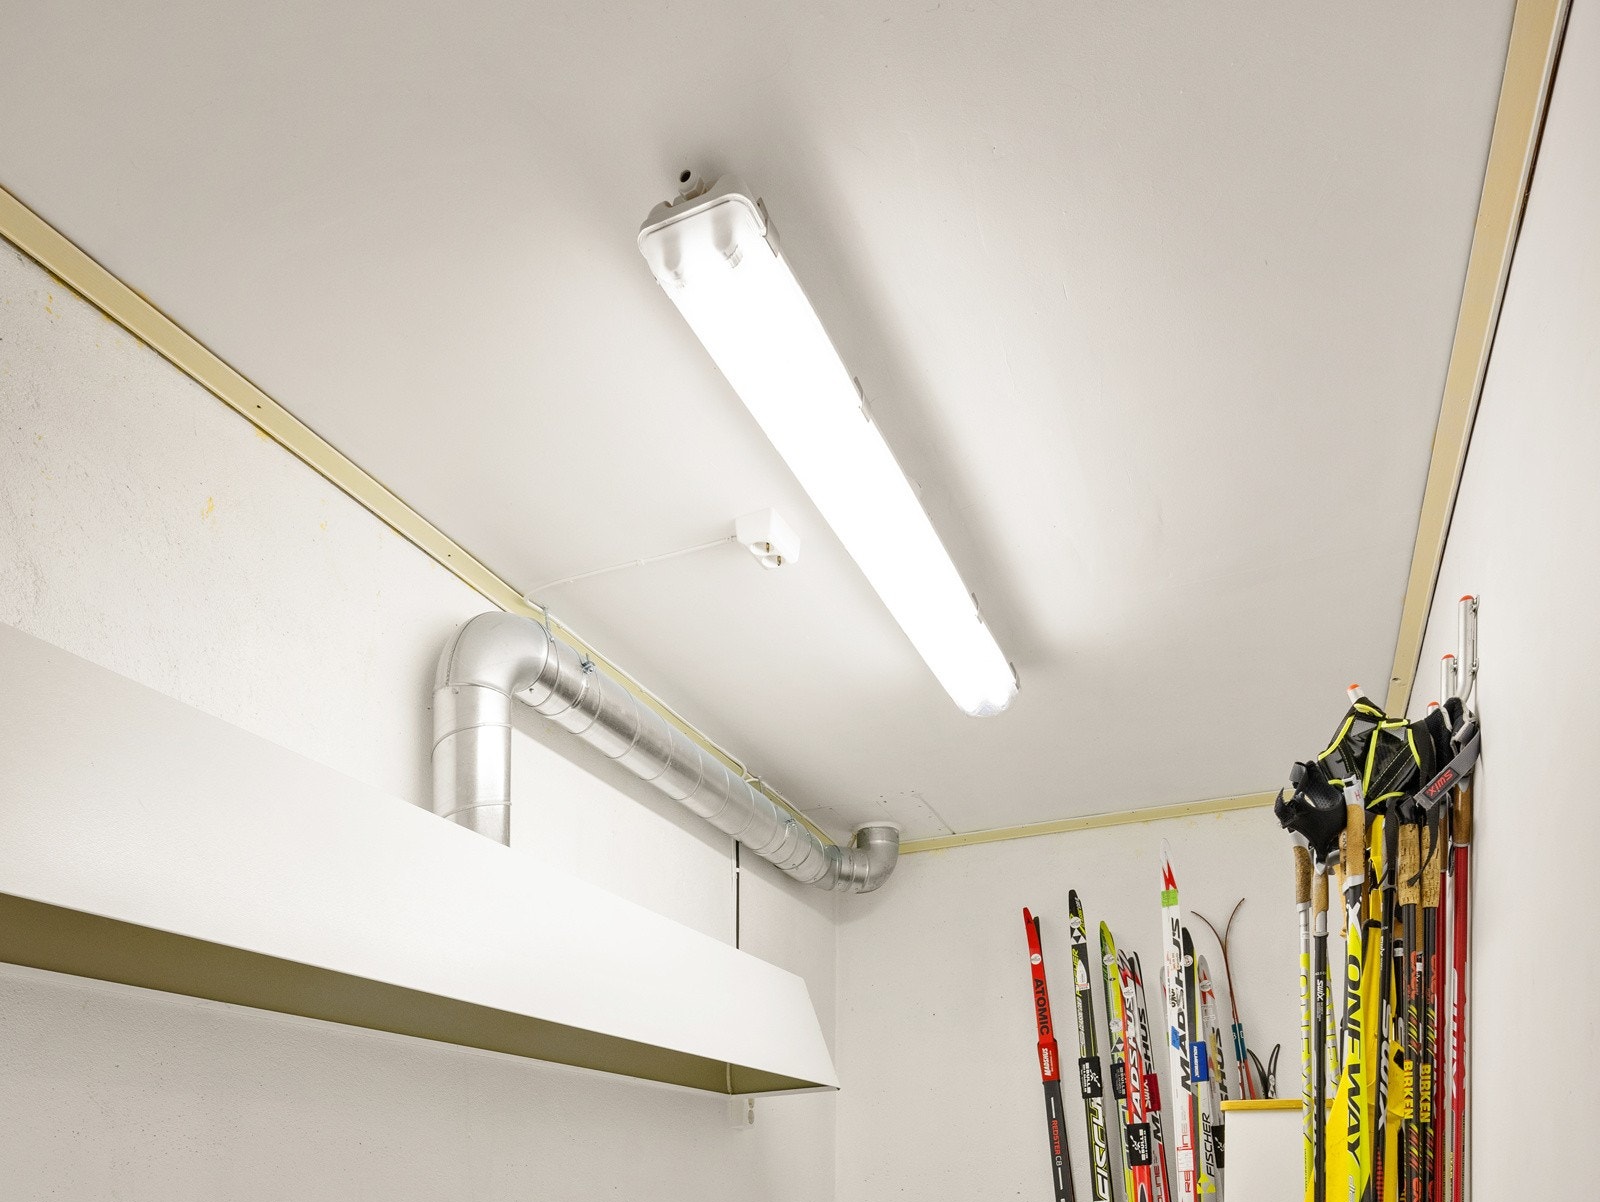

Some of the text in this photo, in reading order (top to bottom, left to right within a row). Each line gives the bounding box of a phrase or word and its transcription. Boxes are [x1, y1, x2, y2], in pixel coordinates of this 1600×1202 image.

[1034, 978, 1050, 1036] ATOMIC
[1403, 1059, 1414, 1120] BIRKEN
[1420, 1063, 1432, 1123] BIRKEN
[1052, 1120, 1061, 1155] REDSTER
[1088, 1097, 1110, 1201] FISCH
[1202, 1112, 1215, 1177] FISCHER
